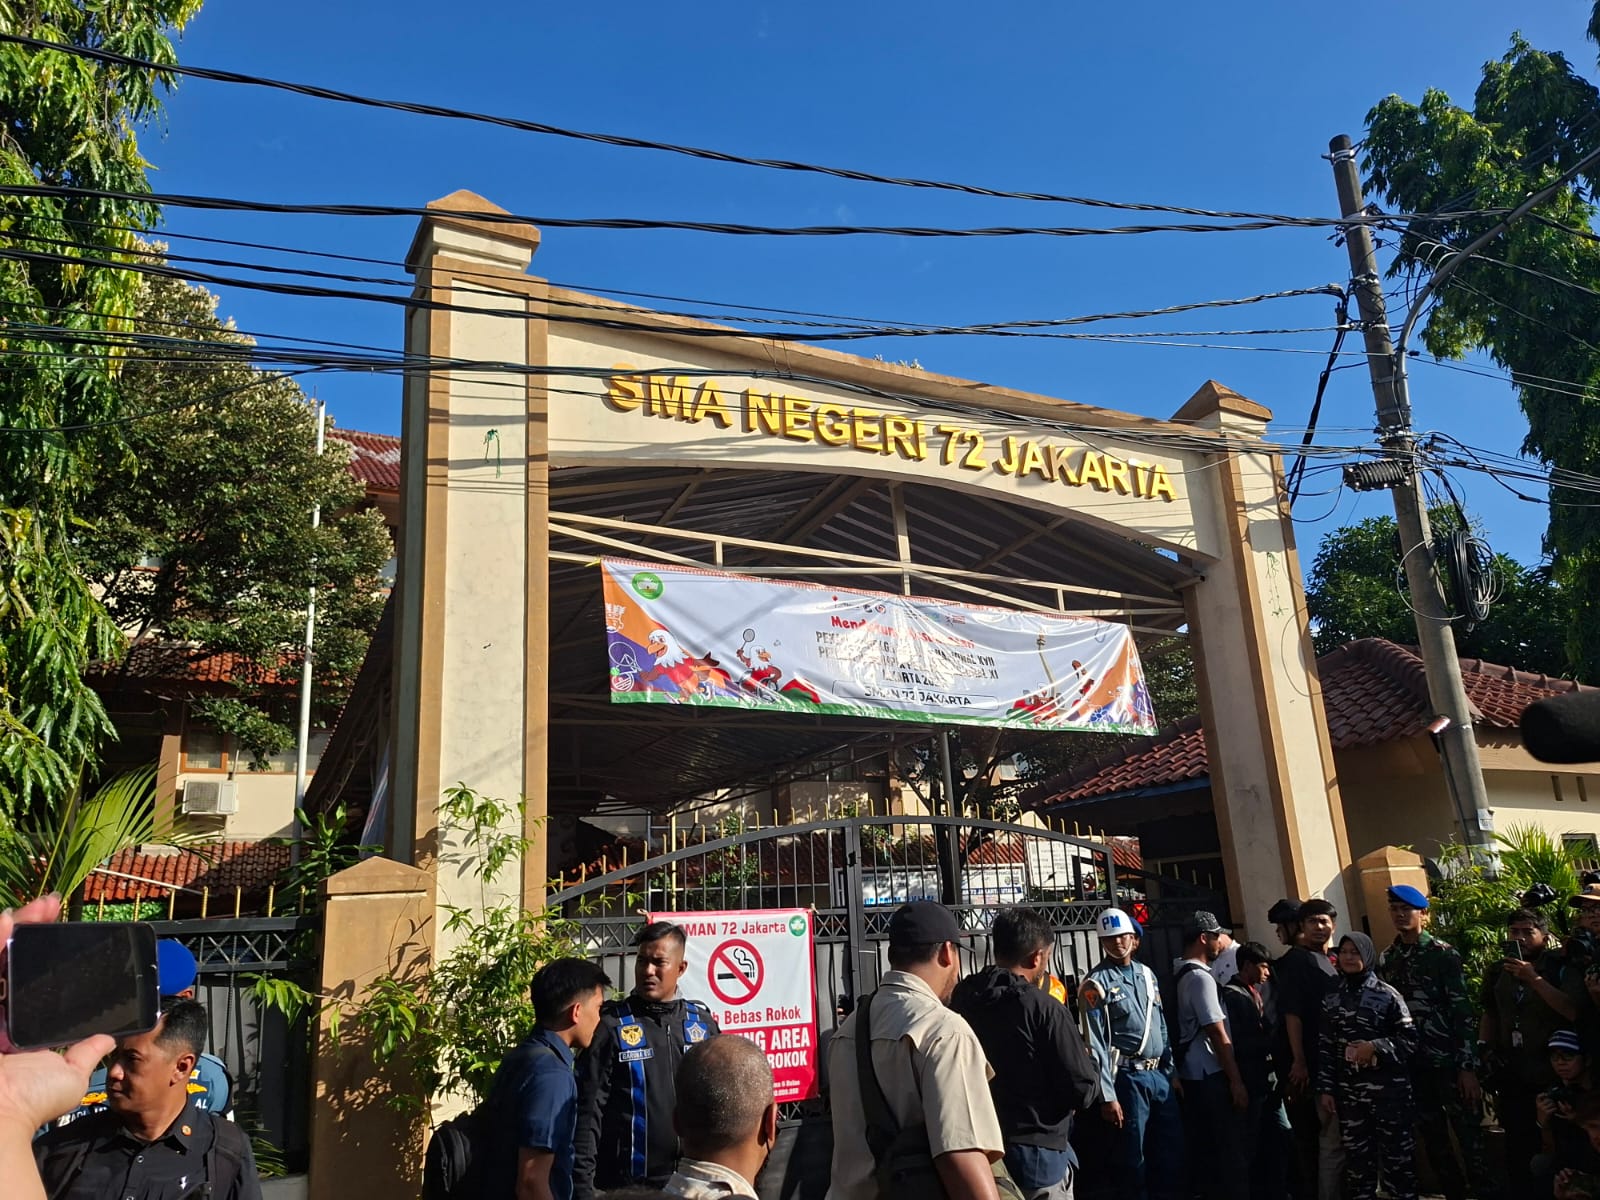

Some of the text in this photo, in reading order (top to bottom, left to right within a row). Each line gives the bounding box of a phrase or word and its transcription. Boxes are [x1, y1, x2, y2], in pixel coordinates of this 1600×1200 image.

[607, 362, 1177, 502] SMA NEGERI 72 JAKARTA
[977, 655, 995, 667] XVII
[920, 691, 972, 706] JAKARTA
[721, 921, 737, 935] 72
[741, 920, 786, 934] Jakarta
[1102, 916, 1121, 930] PM
[724, 1009, 762, 1024] Bebas
[766, 1006, 801, 1021] Rokok
[770, 1027, 810, 1050] AREA
[195, 1098, 208, 1109] AL
